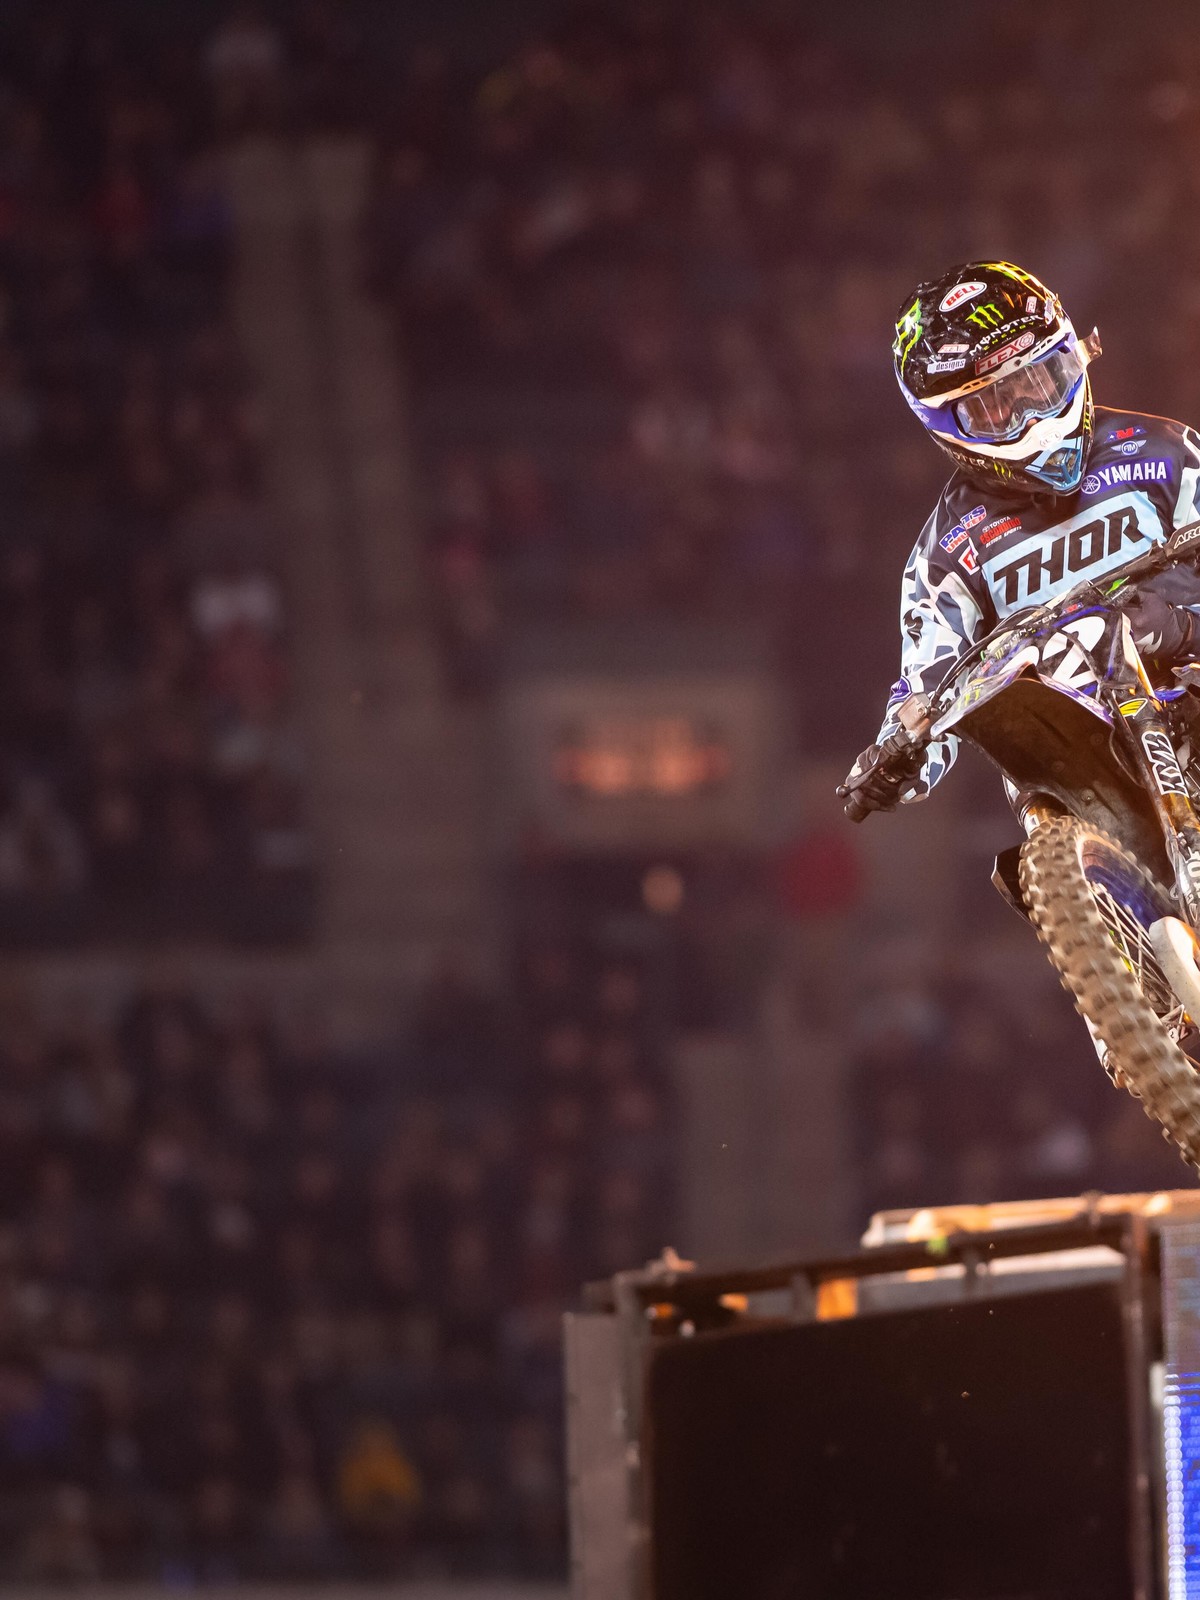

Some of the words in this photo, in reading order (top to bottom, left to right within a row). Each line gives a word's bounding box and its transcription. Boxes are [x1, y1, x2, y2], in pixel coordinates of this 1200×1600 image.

[946, 286, 979, 306] BELL
[969, 315, 1043, 356] MONSTER
[936, 360, 964, 371] designs
[1098, 461, 1167, 486] YAMAHA
[940, 506, 985, 548] PATS
[989, 516, 1011, 529] TOYOTA
[994, 506, 1145, 605] THOR
